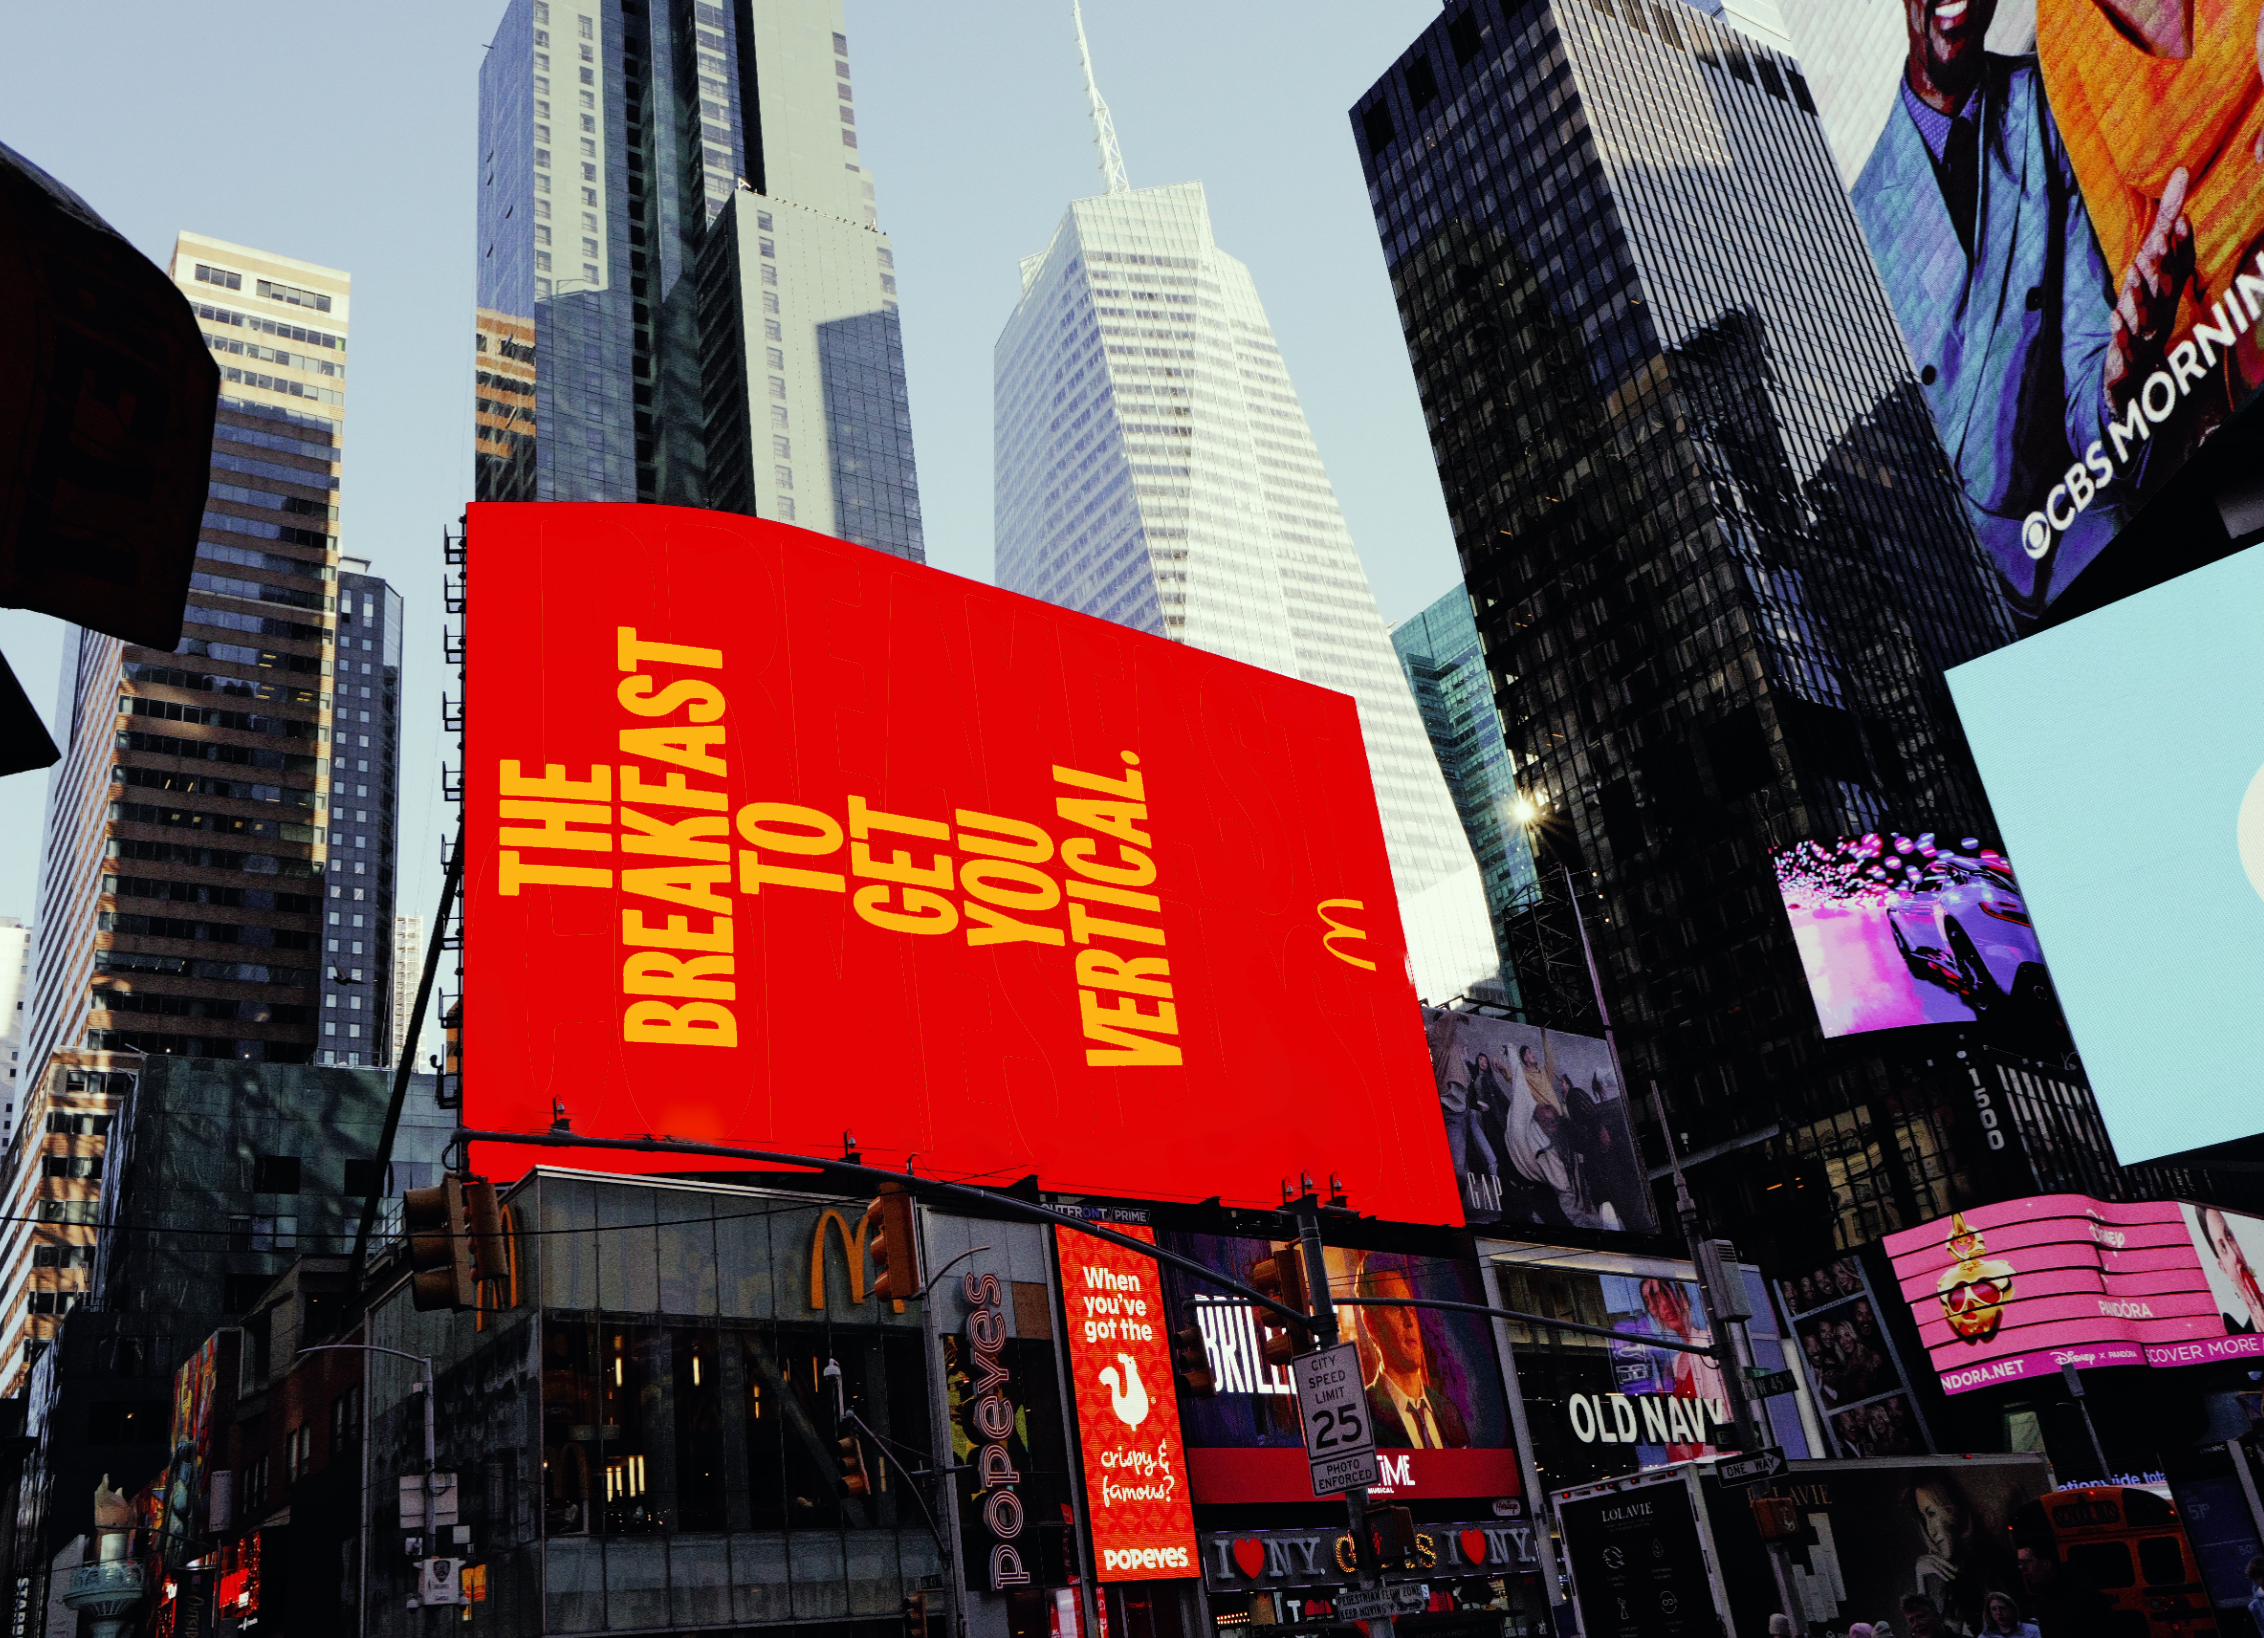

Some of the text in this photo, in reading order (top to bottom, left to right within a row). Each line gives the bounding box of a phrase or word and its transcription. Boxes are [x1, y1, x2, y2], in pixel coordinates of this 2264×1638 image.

[2046, 440, 2114, 532] CBS
[498, 759, 613, 896] THE
[617, 626, 738, 1048] BREAKFAST
[736, 802, 846, 895] TO
[848, 796, 959, 936] GET
[956, 808, 1066, 947] YOU
[1052, 750, 1184, 1067] VERTICAL.
[1967, 1067, 2005, 1151] 1500
[1467, 1171, 1503, 1212] GAP
[1114, 1209, 1147, 1222] PRIME
[1083, 1266, 1141, 1293] When
[1083, 1294, 1147, 1322] you've
[1084, 1317, 1153, 1343] got the
[2208, 1337, 2260, 1356] MORE
[1311, 1355, 1336, 1371] CITY
[1308, 1370, 1346, 1389] SPEED
[1755, 1378, 1768, 1395] W
[1770, 1375, 1785, 1391] 45
[1315, 1387, 1345, 1404] LIMIT
[1312, 1403, 1363, 1450] 25
[1569, 1393, 1725, 1444] OLD NAVY
[1100, 1449, 1157, 1477] crispy
[1327, 1459, 1360, 1476] PHOTO
[1726, 1456, 1776, 1477] ONE WAY
[1102, 1475, 1175, 1508] famous?
[1319, 1469, 1372, 1490] ENFORCED
[1601, 1501, 1654, 1523] LOLAVIE
[1216, 1538, 1232, 1580] I
[1441, 1529, 1463, 1567] I
[11, 1577, 29, 1638] STARB
[1337, 1584, 1421, 1607] PEDESTRIAN FLOW ZONE
[1340, 1604, 1387, 1620] KEEP MOVING
